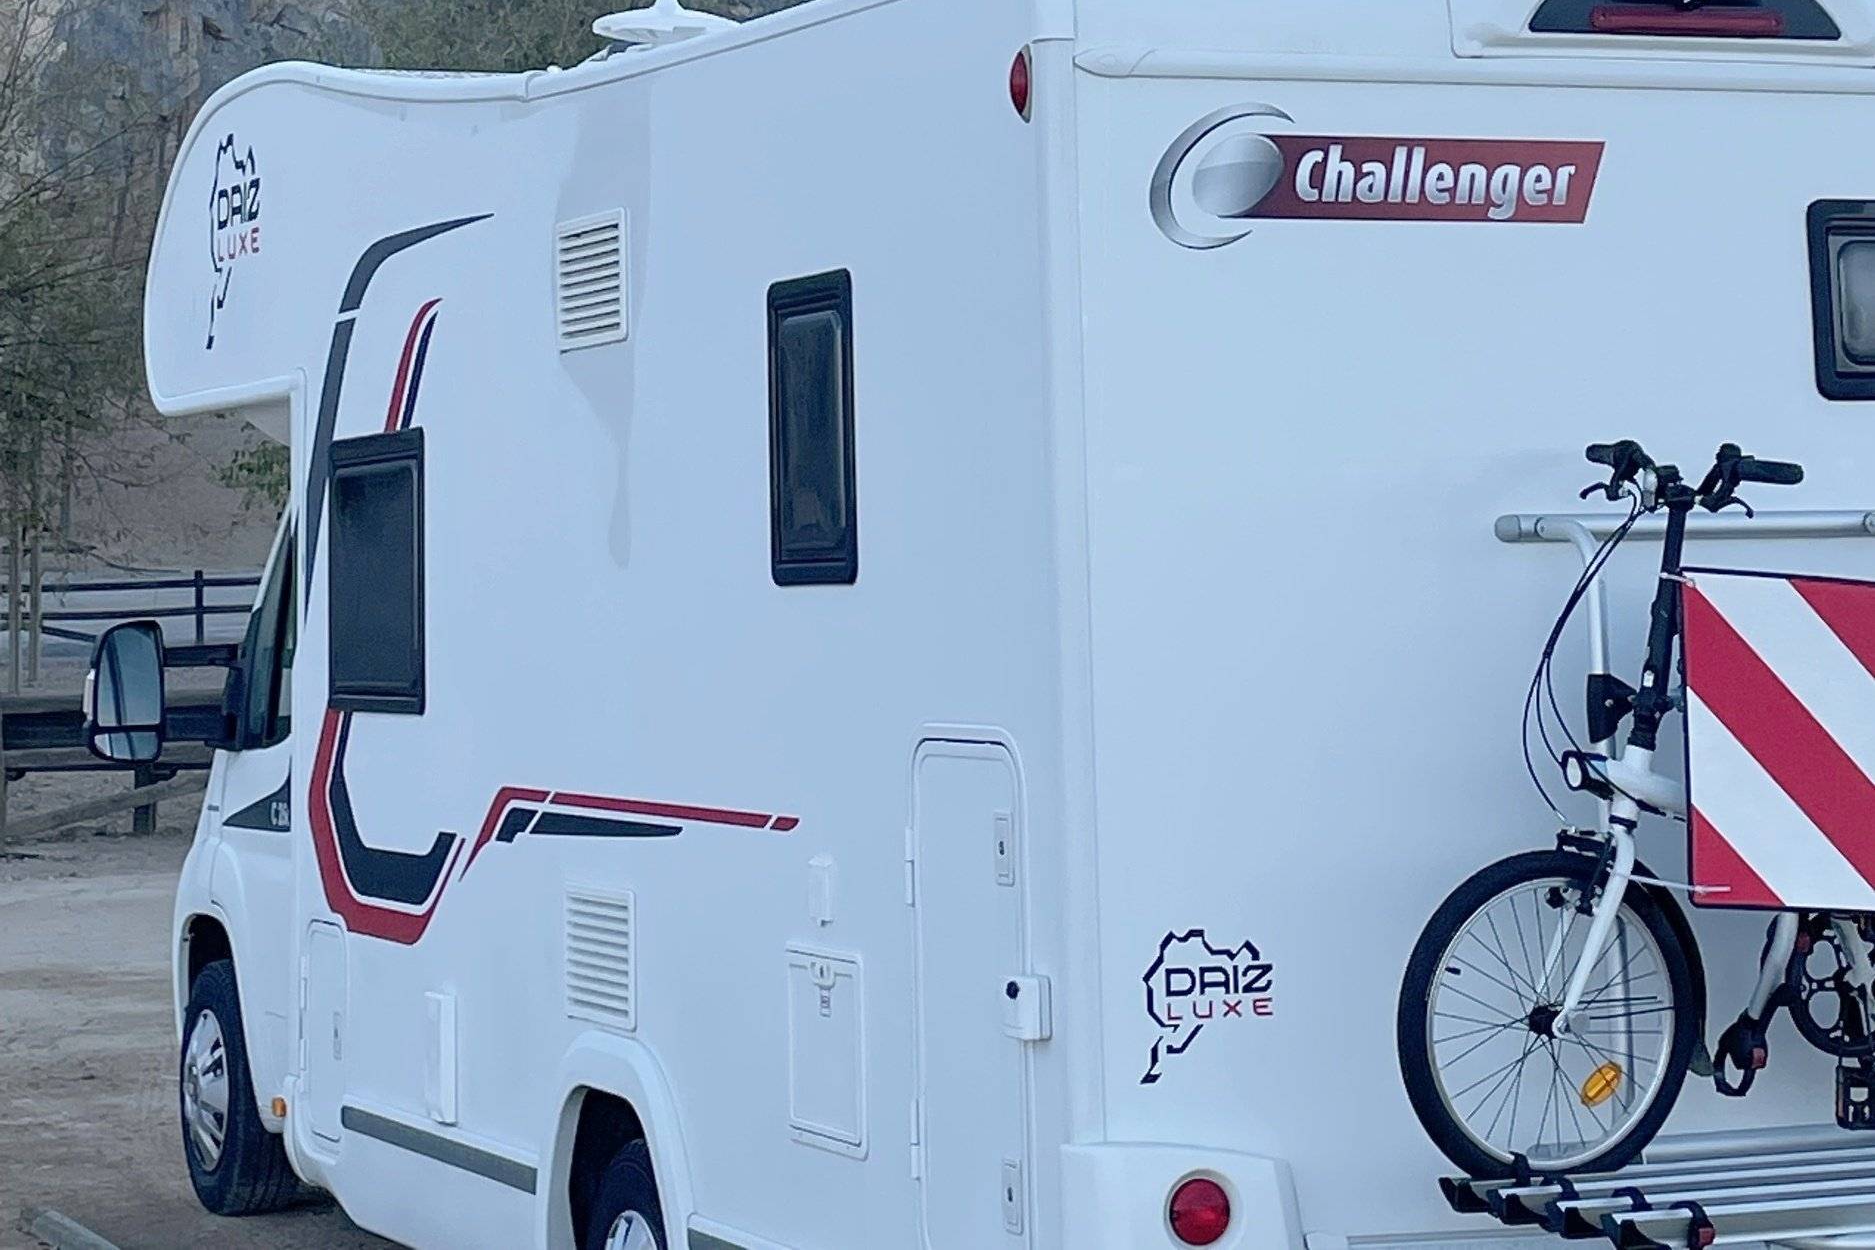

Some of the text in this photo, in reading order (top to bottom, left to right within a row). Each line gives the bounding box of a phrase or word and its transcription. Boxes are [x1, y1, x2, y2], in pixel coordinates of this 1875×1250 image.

[1295, 144, 1575, 219] Challenger
[217, 178, 260, 230] DAIZ
[217, 227, 259, 262] LUXE
[1165, 964, 1273, 997] DAIZ
[1167, 998, 1273, 1021] LUXE
